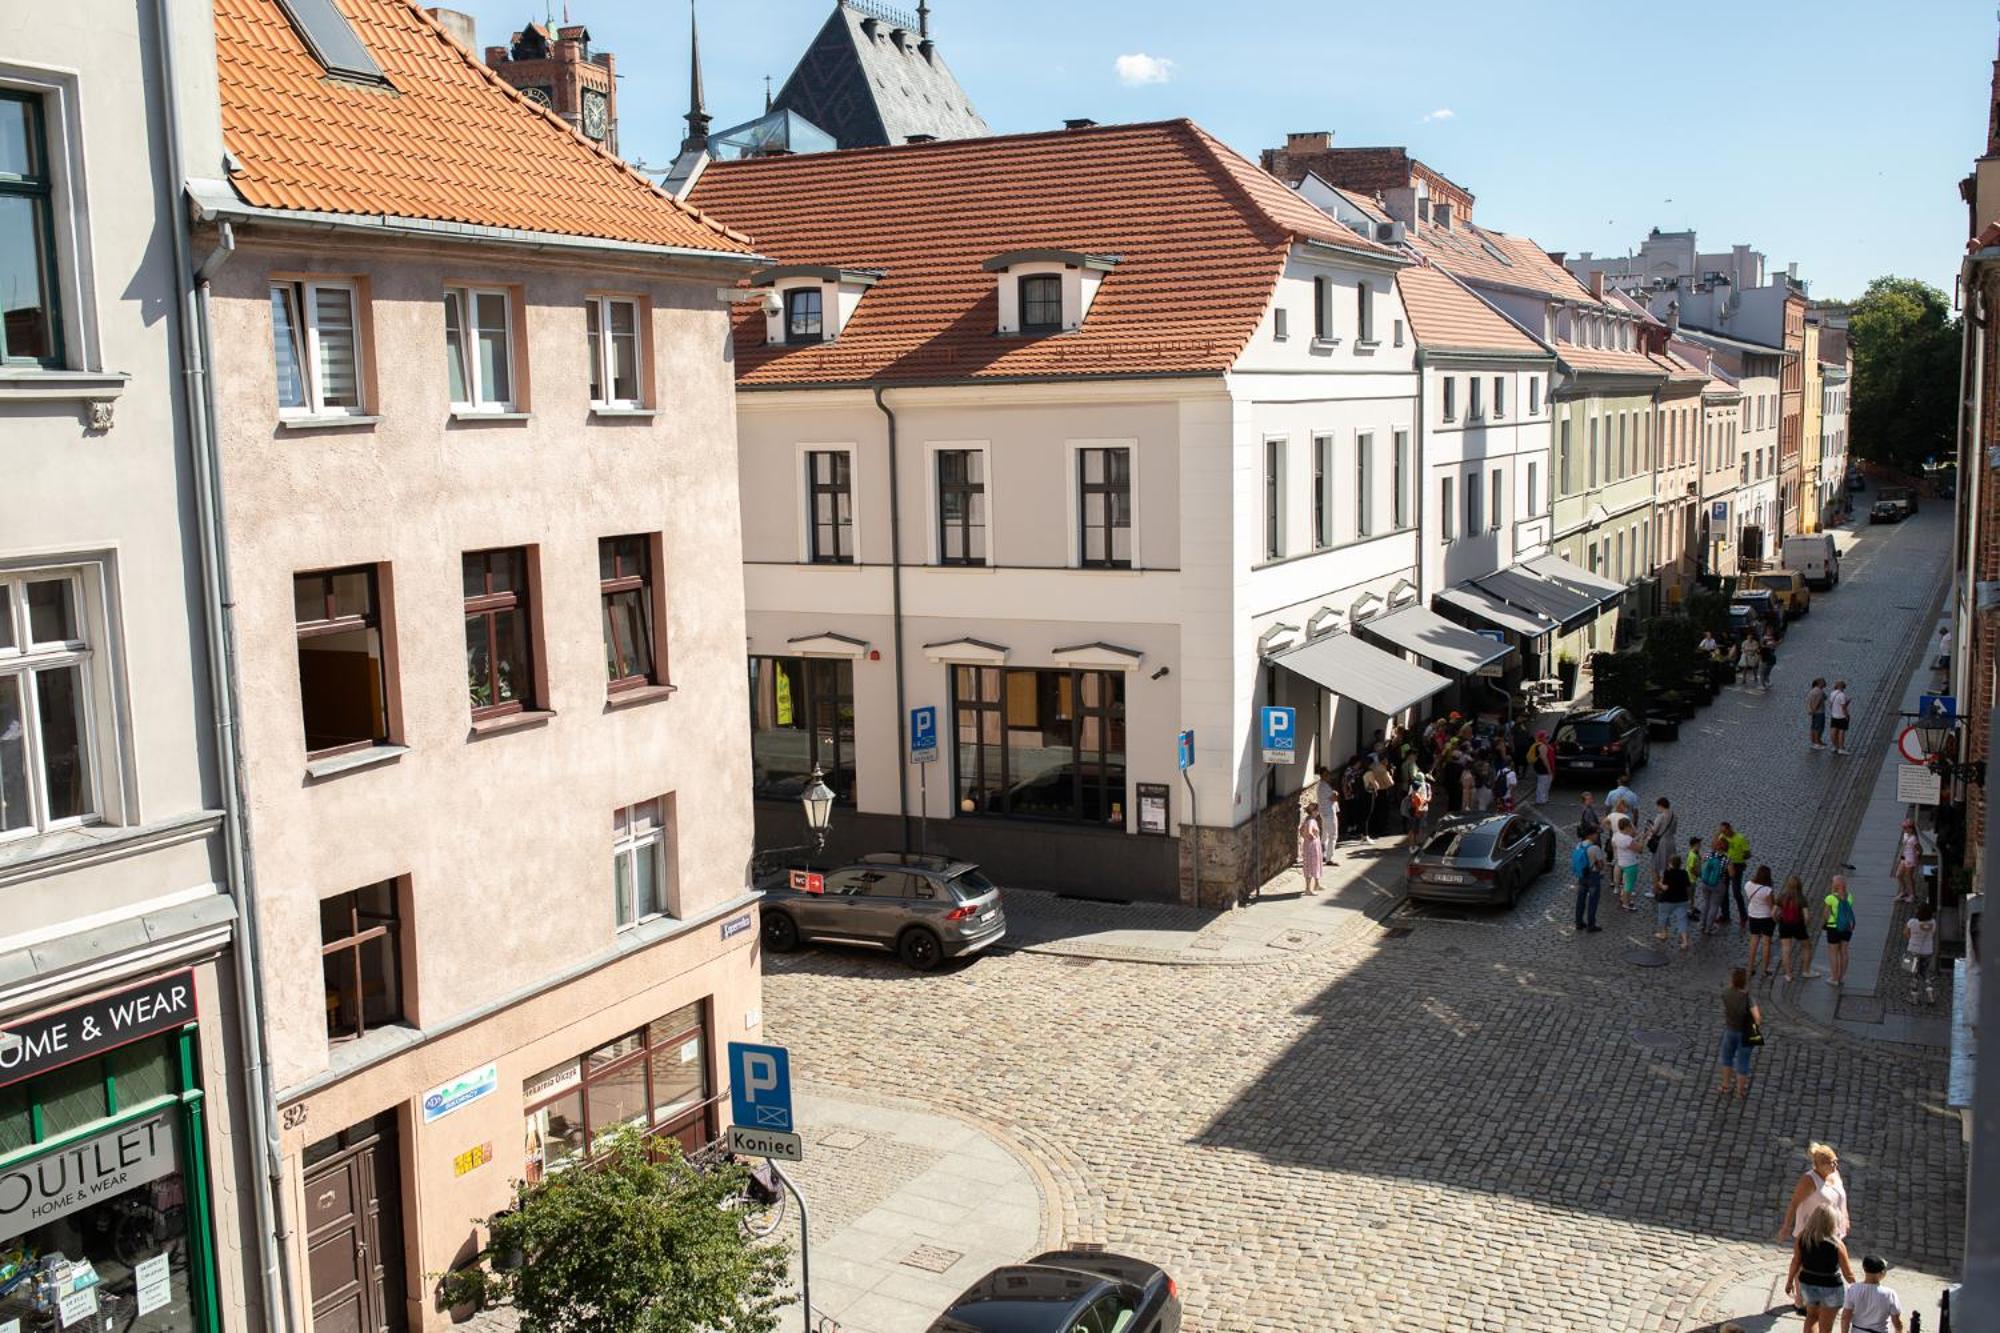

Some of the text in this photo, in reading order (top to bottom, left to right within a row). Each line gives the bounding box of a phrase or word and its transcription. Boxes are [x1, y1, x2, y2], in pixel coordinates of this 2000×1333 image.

[917, 711, 931, 737] P
[1269, 711, 1288, 737] P
[81, 1015, 103, 1041] &
[109, 985, 187, 1031] WEAR
[742, 1051, 777, 1103] P
[0, 1117, 162, 1214] OUTLET
[734, 1131, 794, 1155] Koniec
[32, 1172, 128, 1219] HOME & WEAR
